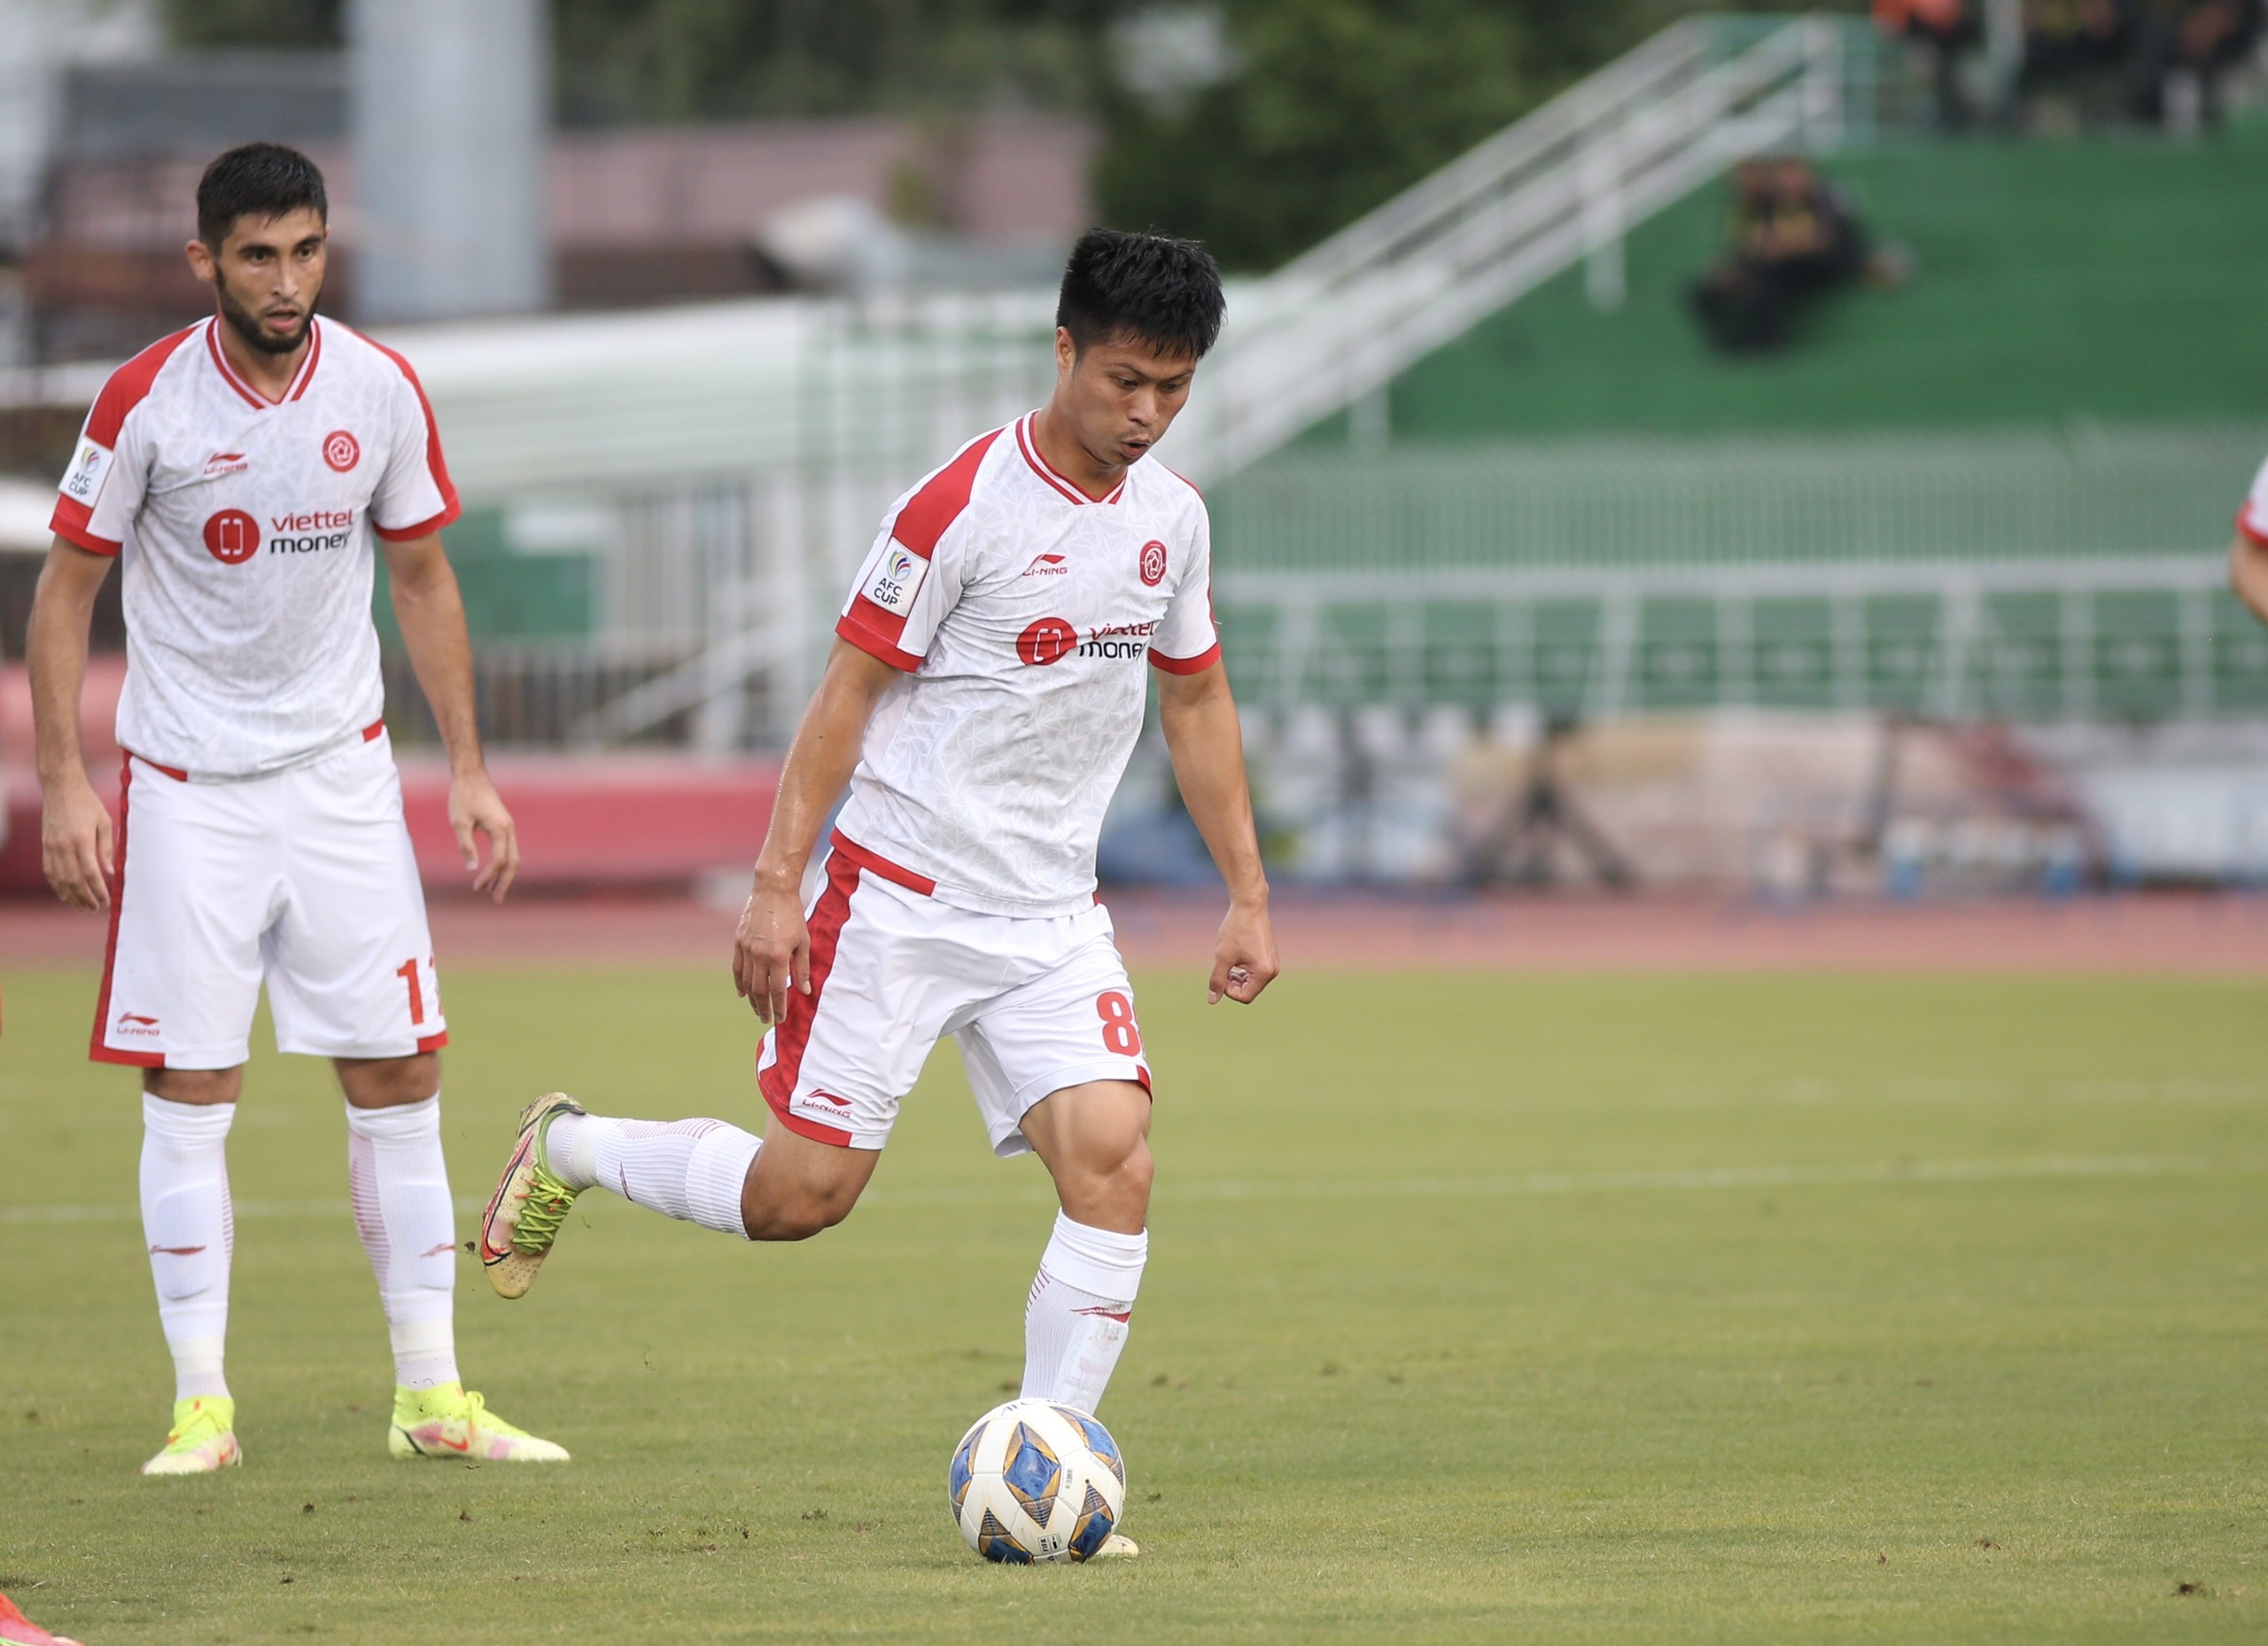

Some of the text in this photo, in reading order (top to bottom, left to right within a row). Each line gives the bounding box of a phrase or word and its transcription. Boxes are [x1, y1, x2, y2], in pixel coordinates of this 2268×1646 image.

[68, 480, 88, 496] CUP
[73, 471, 92, 488] AFC
[270, 508, 353, 532] viettel
[269, 529, 353, 555] money
[874, 587, 898, 605] CUP
[878, 577, 903, 597] AFC
[1079, 641, 1146, 660] mone
[396, 957, 445, 1026] 1
[1096, 990, 1141, 1058] 8
[802, 1099, 851, 1119] LI-NING
